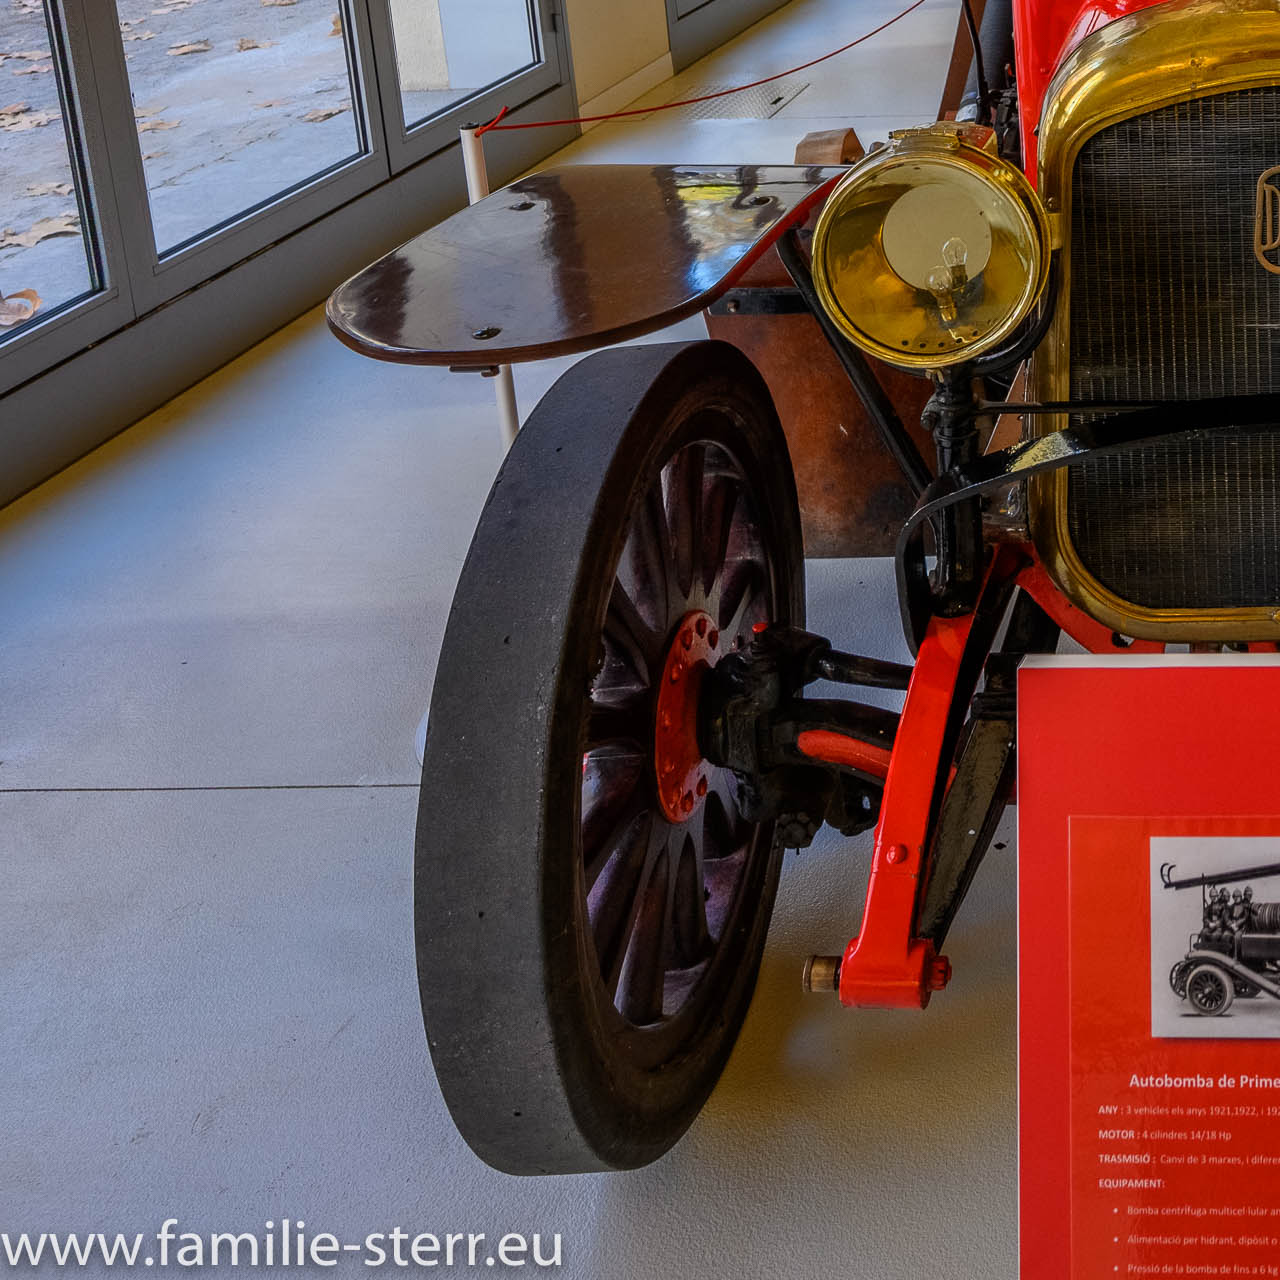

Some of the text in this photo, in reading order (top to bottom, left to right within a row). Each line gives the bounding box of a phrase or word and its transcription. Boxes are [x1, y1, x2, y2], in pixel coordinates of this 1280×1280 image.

[1129, 1073, 1213, 1088] Autobomba
[1218, 1073, 1235, 1088] de
[1098, 1105, 1118, 1115] ANY
[1126, 1106, 1132, 1115] 3
[1133, 1105, 1169, 1115] vehicles
[1171, 1106, 1184, 1115] els
[1186, 1107, 1207, 1117] anys
[1098, 1130, 1135, 1139] MOTOR
[1142, 1130, 1148, 1139] 4
[1150, 1129, 1187, 1140] cilindres
[1190, 1130, 1217, 1141] 14/18
[1219, 1131, 1232, 1141] Hp
[1098, 1153, 1150, 1164] TRASMISIÓ
[1160, 1154, 1185, 1164] Canvi
[1187, 1154, 1199, 1164] de
[1201, 1155, 1206, 1164] 3
[1098, 1178, 1166, 1189] EQUIPAMENT:
[1127, 1206, 1159, 1215] Bomba
[1127, 1234, 1181, 1245] Alimentació
[1183, 1237, 1198, 1246] per
[1127, 1264, 1160, 1273] Pressió
[1162, 1264, 1174, 1273] de
[1175, 1264, 1184, 1273] la
[1186, 1264, 1217, 1274] bomba
[1219, 1264, 1231, 1274] de
[1233, 1264, 1250, 1274] fins
[1259, 1265, 1265, 1274] 6
[1268, 1264, 1279, 1276] kg
